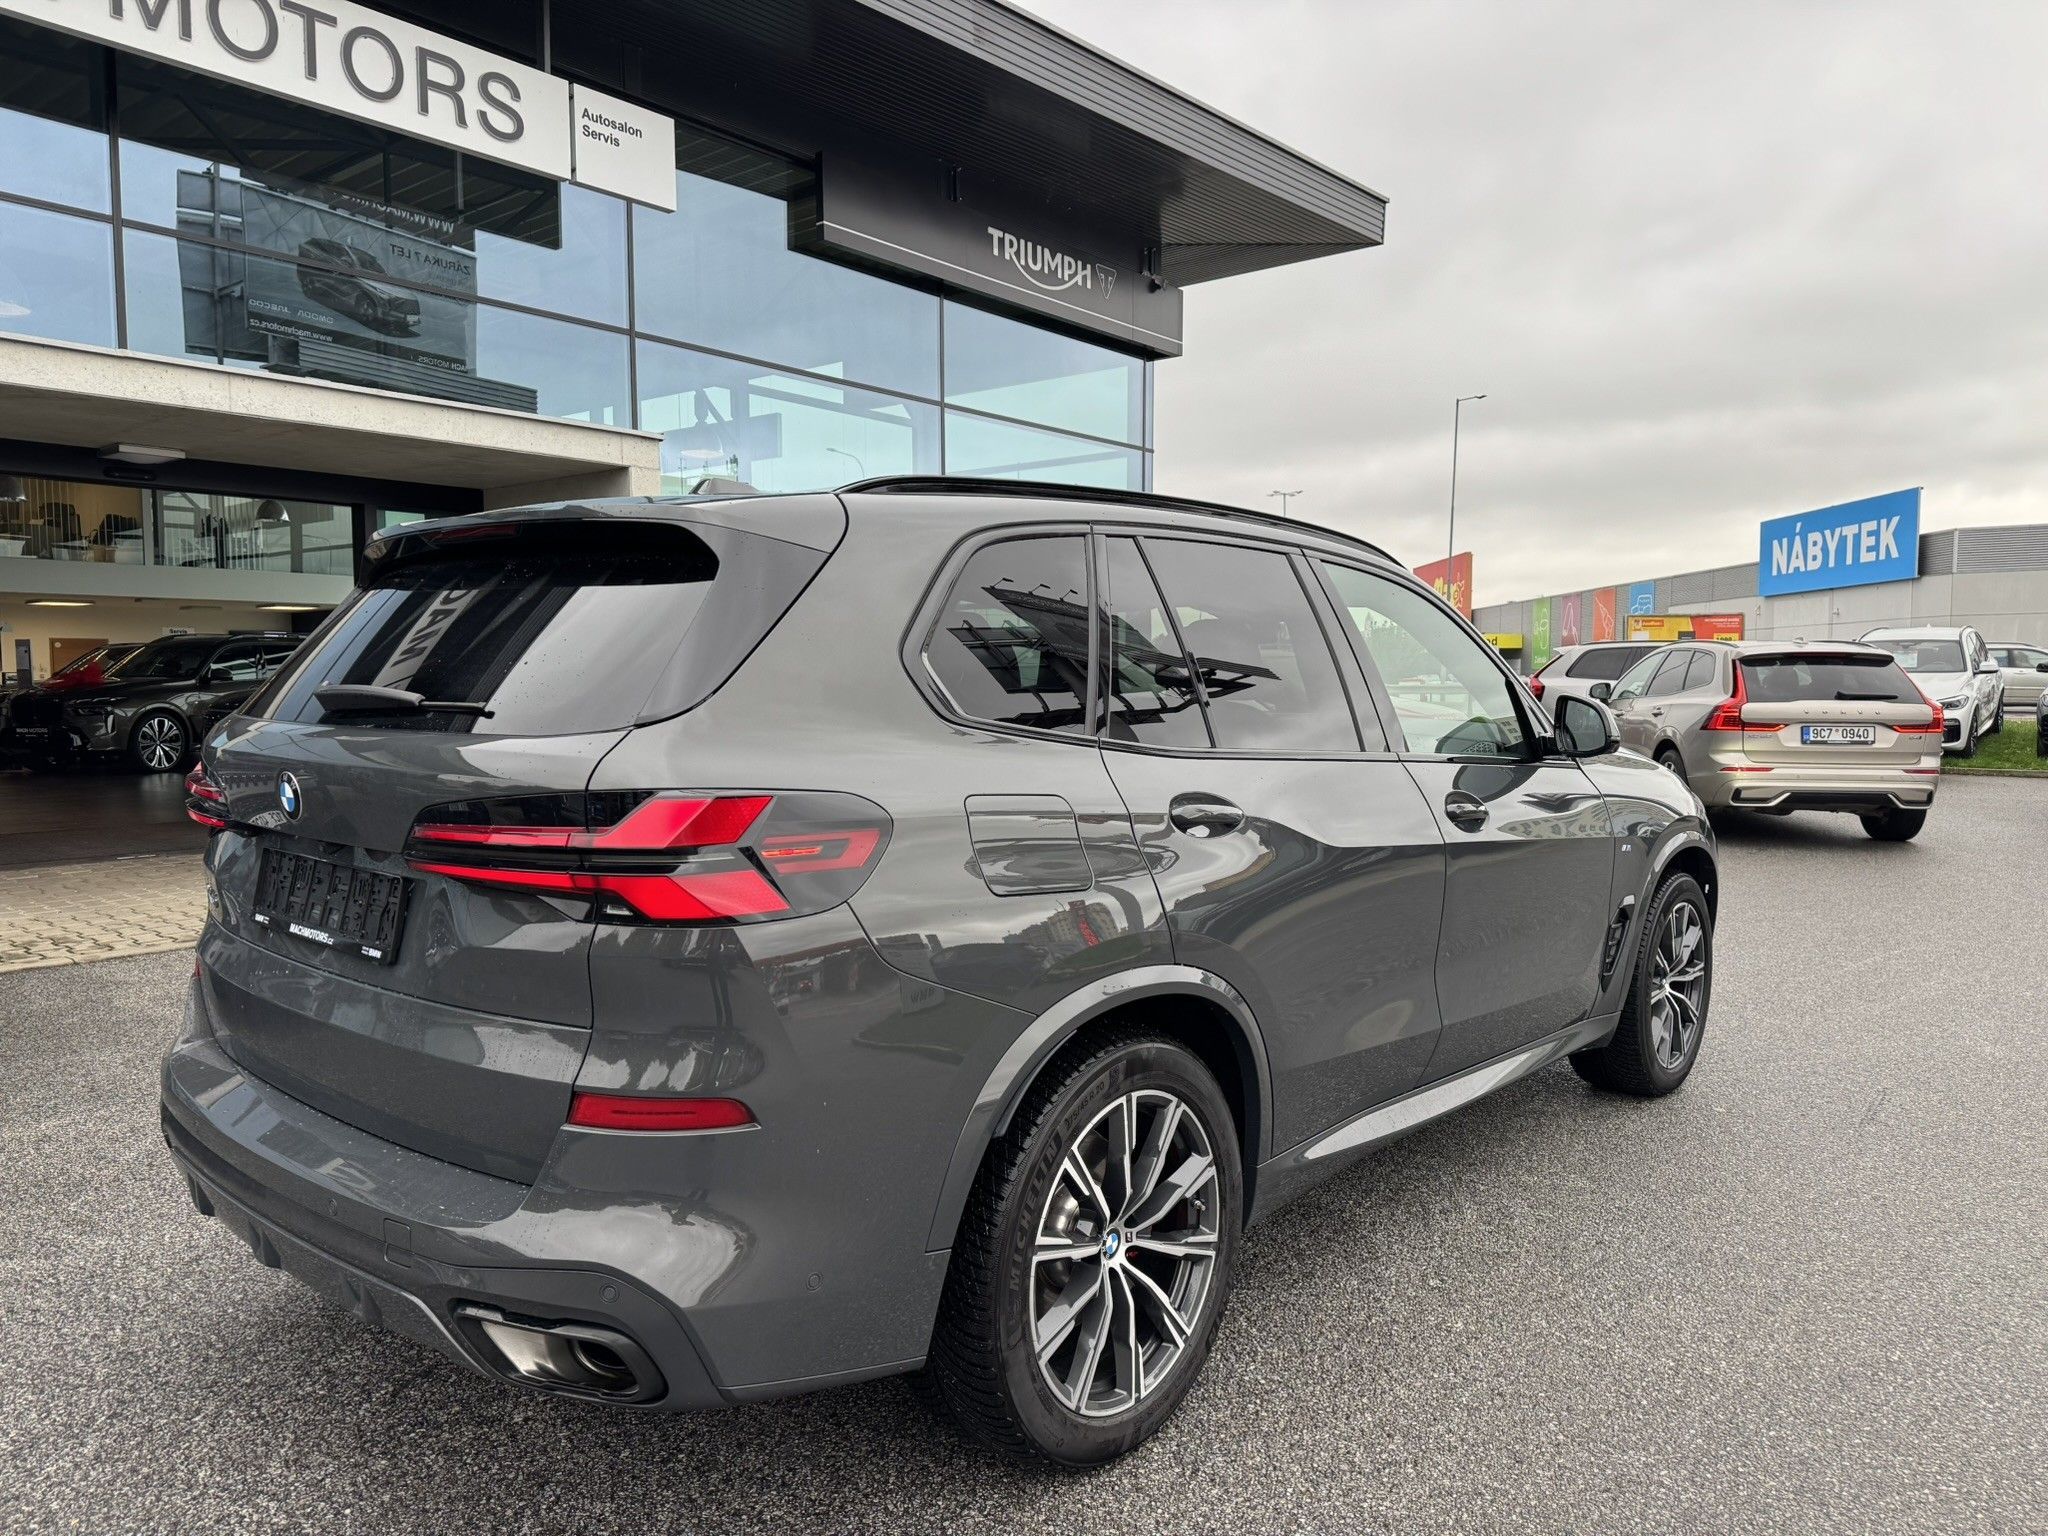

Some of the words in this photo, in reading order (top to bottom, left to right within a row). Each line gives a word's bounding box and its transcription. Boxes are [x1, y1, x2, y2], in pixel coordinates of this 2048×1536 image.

[582, 107, 643, 139] Autosalon
[582, 124, 620, 147] Servis
[987, 226, 1092, 291] TRIUMPH
[1771, 515, 1901, 577] NÁBYTEK
[1812, 728, 1832, 739] 9C7
[1841, 728, 1870, 739] 0940
[1008, 1126, 1064, 1291] MICHELIN
